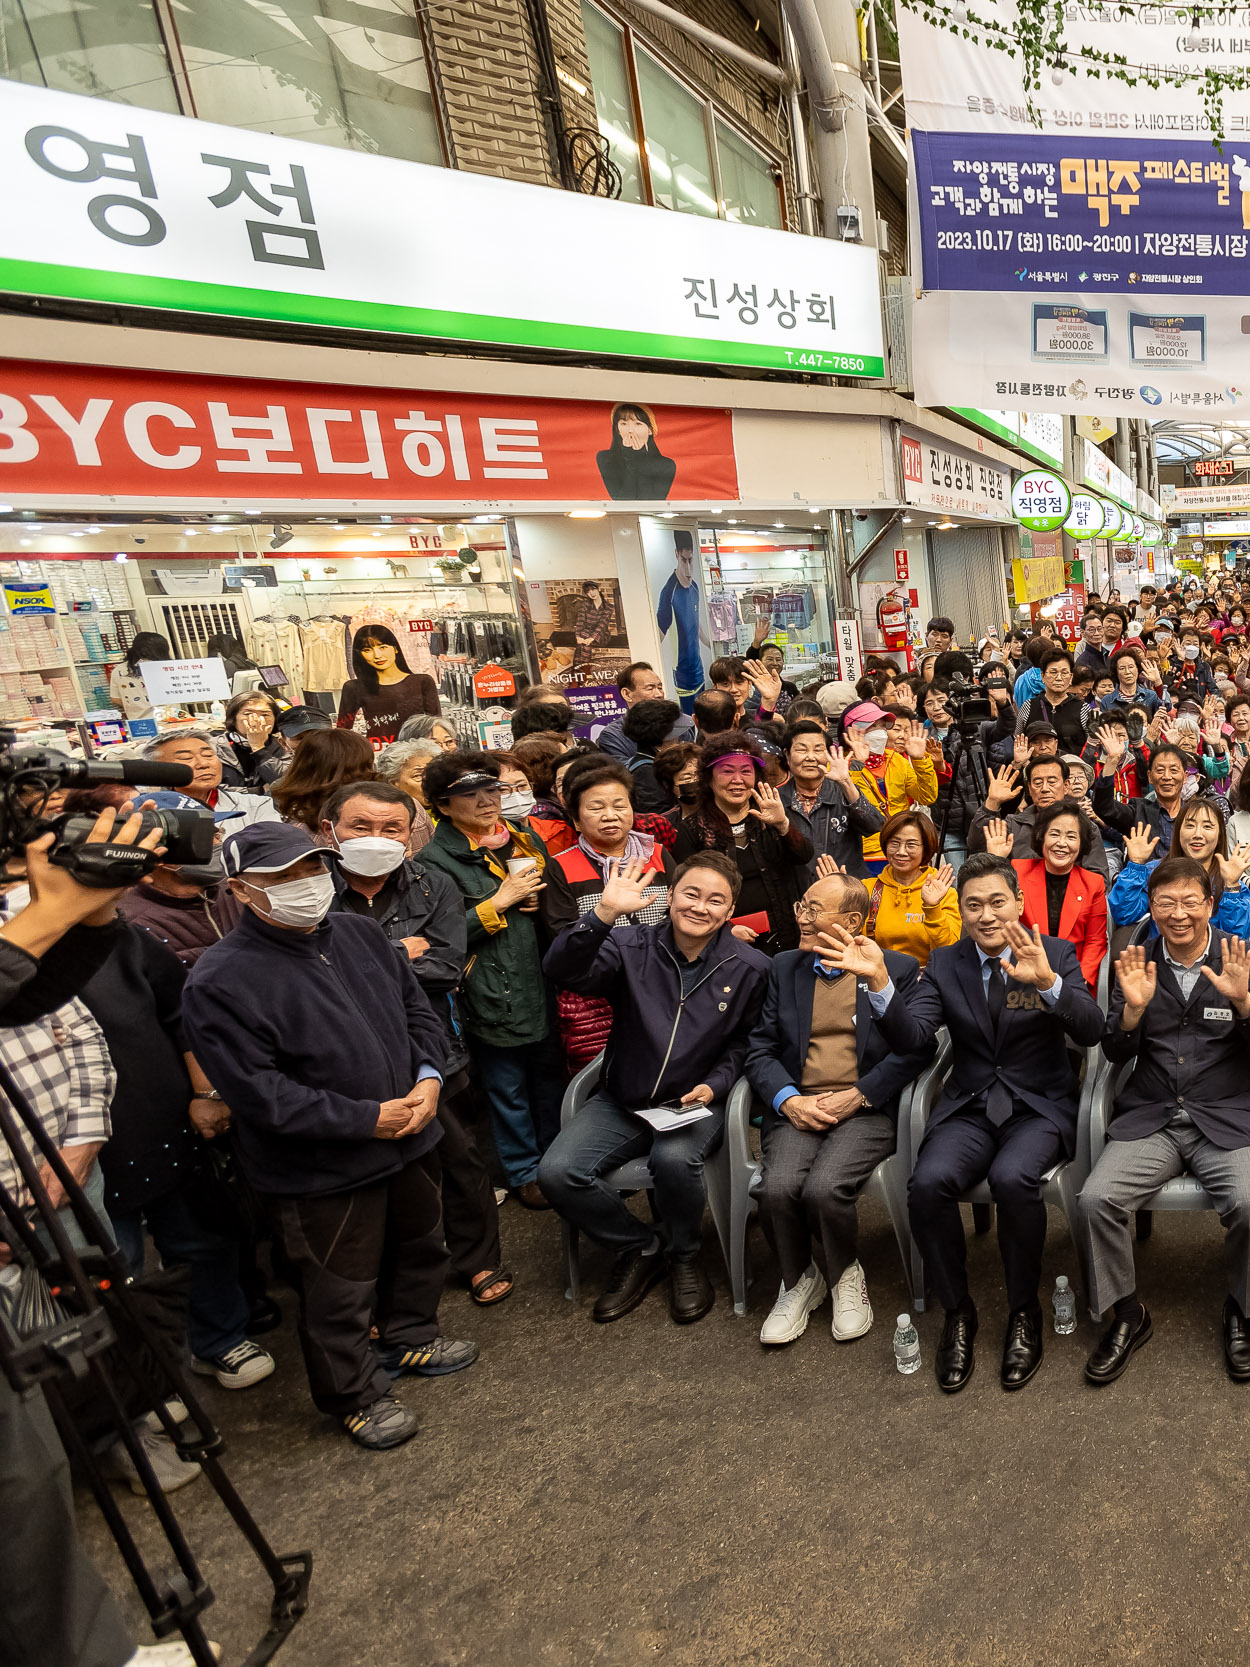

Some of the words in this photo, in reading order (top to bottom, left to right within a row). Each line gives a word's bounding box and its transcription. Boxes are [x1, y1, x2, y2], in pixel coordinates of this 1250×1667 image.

[1059, 158, 1142, 228] 맥주
[1144, 160, 1231, 206] 페스티벌
[937, 230, 1014, 251] 2023.10.17
[1017, 233, 1043, 253] (화)
[1046, 233, 1130, 254] 16:00~20:00
[1143, 232, 1248, 258] 자양전통시장
[1028, 271, 1069, 283] 서울특별시
[1092, 272, 1120, 283] 광진구
[1141, 273, 1181, 284] 자양전통시장
[682, 275, 839, 332] 진성상회
[784, 350, 865, 372] T.447-7850
[904, 443, 921, 479] BYC
[929, 449, 974, 493] 진성상회
[980, 467, 1003, 501] 직영점
[1024, 480, 1054, 494] BYC
[1018, 496, 1062, 514] 직영점
[1076, 511, 1089, 526] 닭
[409, 535, 443, 549] BYC
[1056, 609, 1075, 622] 오리
[412, 621, 431, 631] BYC
[841, 624, 853, 652] 타월
[548, 672, 586, 685] NIGHT
[105, 849, 147, 860] FUJINON
